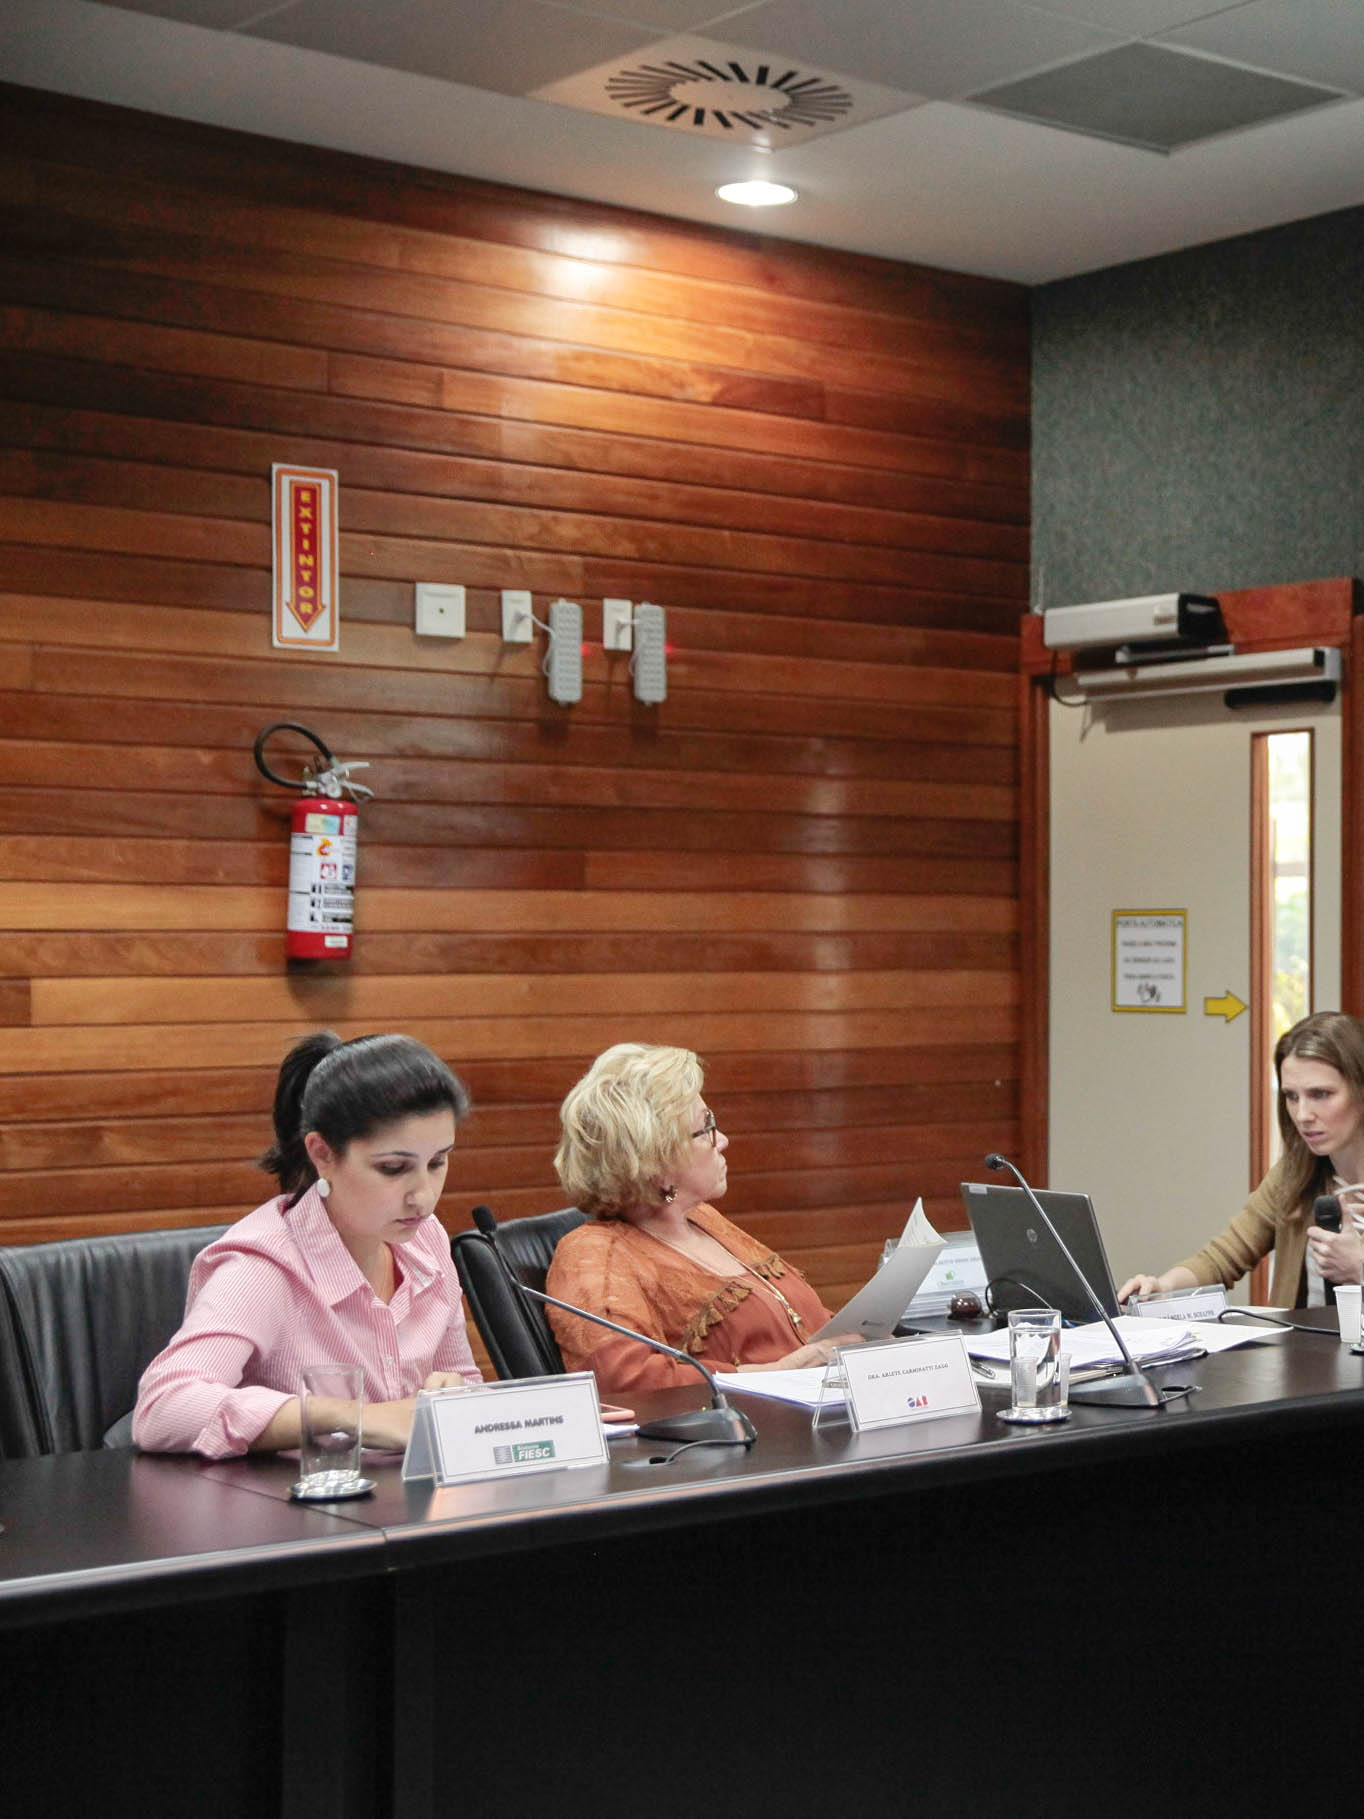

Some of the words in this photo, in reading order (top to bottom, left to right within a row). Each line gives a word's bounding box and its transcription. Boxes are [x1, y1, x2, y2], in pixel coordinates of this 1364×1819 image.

[298, 489, 315, 615] EXTINTOR
[907, 1395, 928, 1408] OAB
[474, 1420, 522, 1434] ANDRESSA
[524, 1415, 564, 1428] MARTINS
[518, 1447, 550, 1461] FIESC
